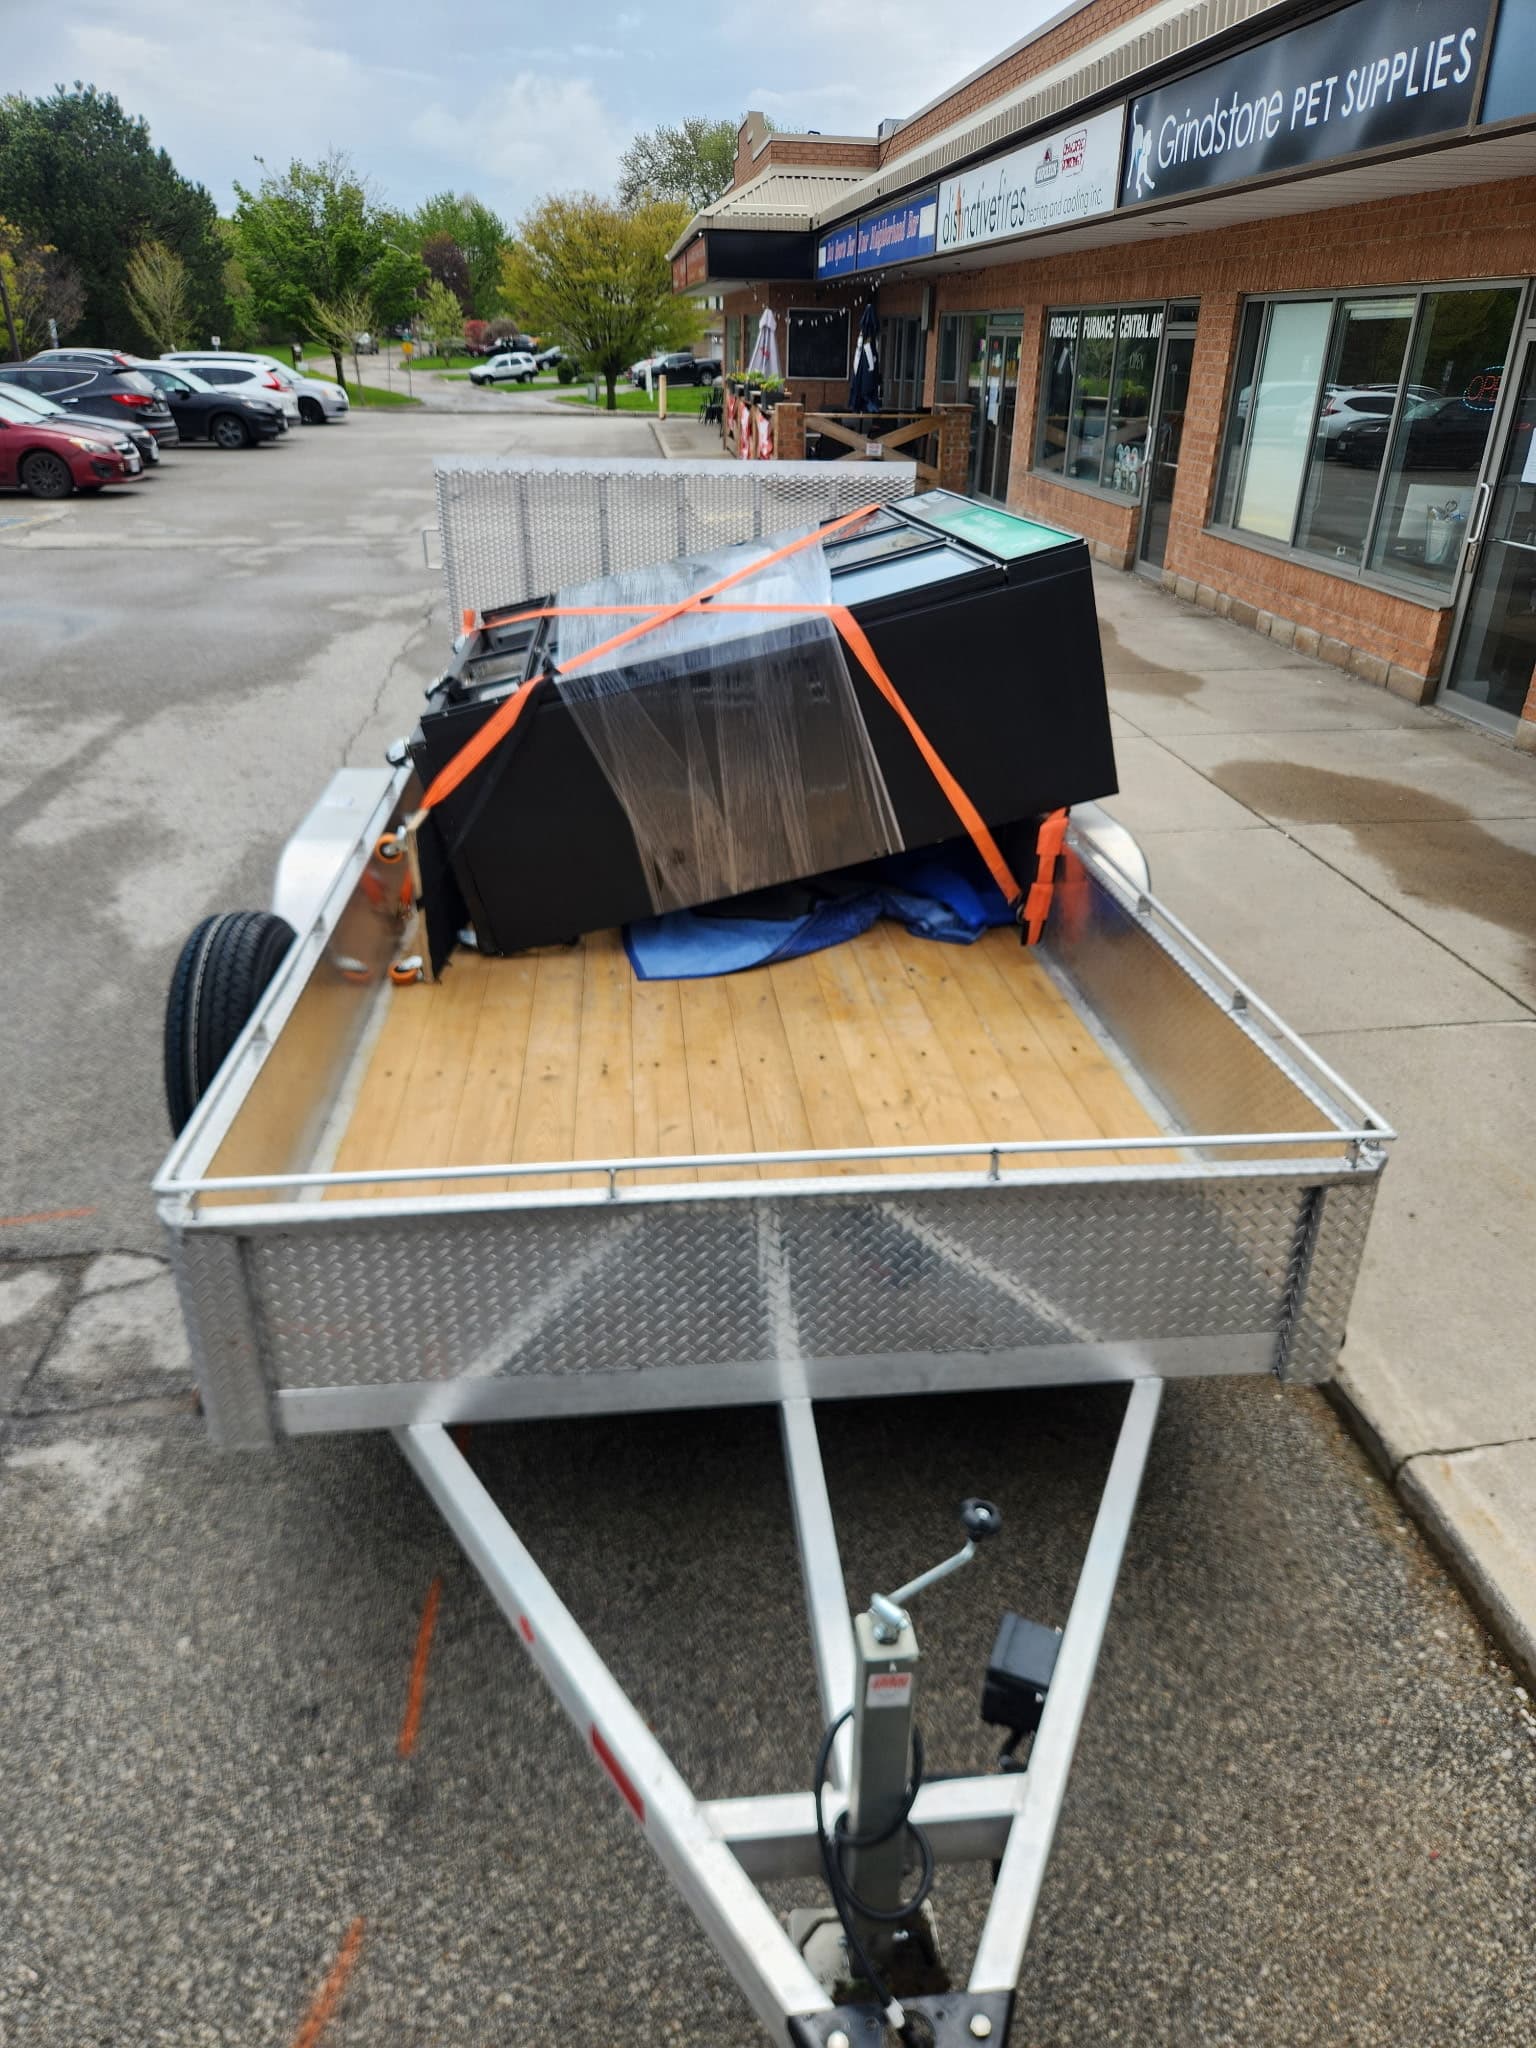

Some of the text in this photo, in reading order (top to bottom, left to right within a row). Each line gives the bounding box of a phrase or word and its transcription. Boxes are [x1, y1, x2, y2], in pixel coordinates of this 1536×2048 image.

[1157, 27, 1477, 169] Grindstone PET SUPPLIES
[1049, 312, 1163, 340] FIREPLACE FURNACE CENTRAL AIR
[1468, 375, 1503, 402] OPE
